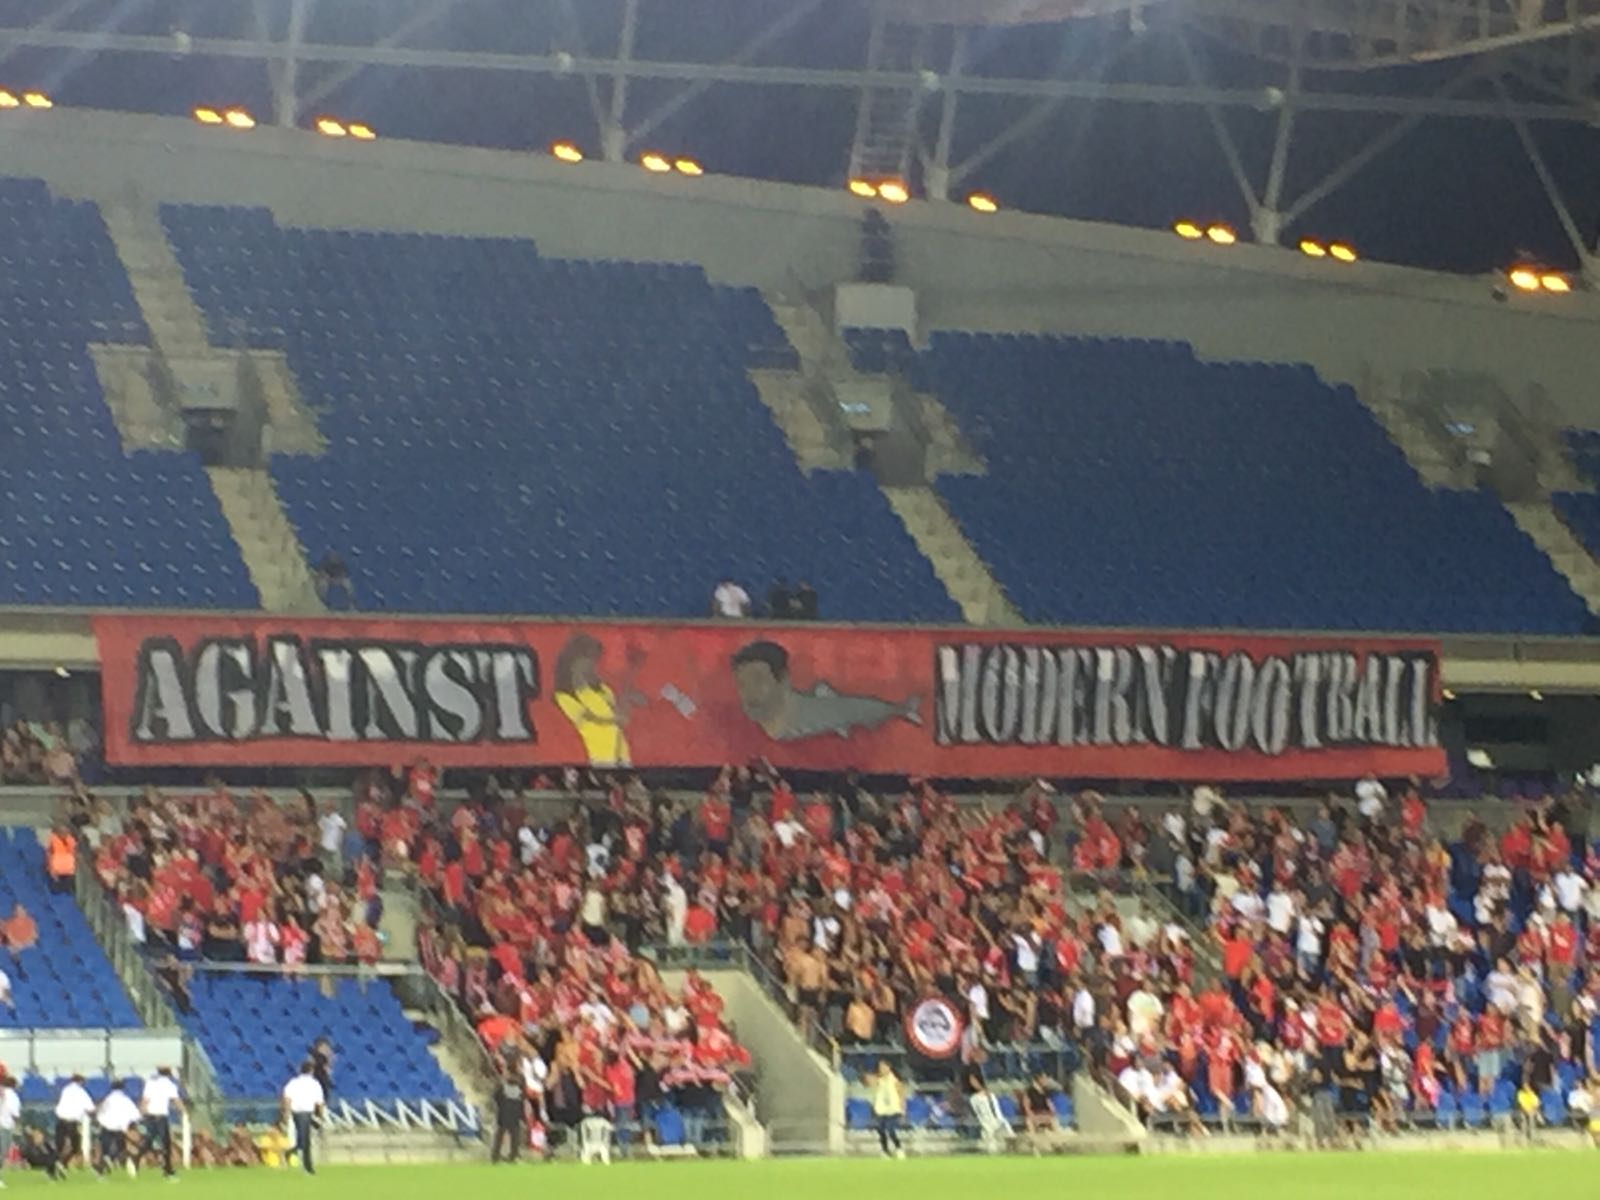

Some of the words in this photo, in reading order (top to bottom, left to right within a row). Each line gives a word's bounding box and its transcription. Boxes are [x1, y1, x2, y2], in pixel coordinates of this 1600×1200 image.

[135, 637, 537, 743] AGAINST
[936, 644, 1178, 746] MODERN
[1180, 648, 1439, 755] FOOTBALL
